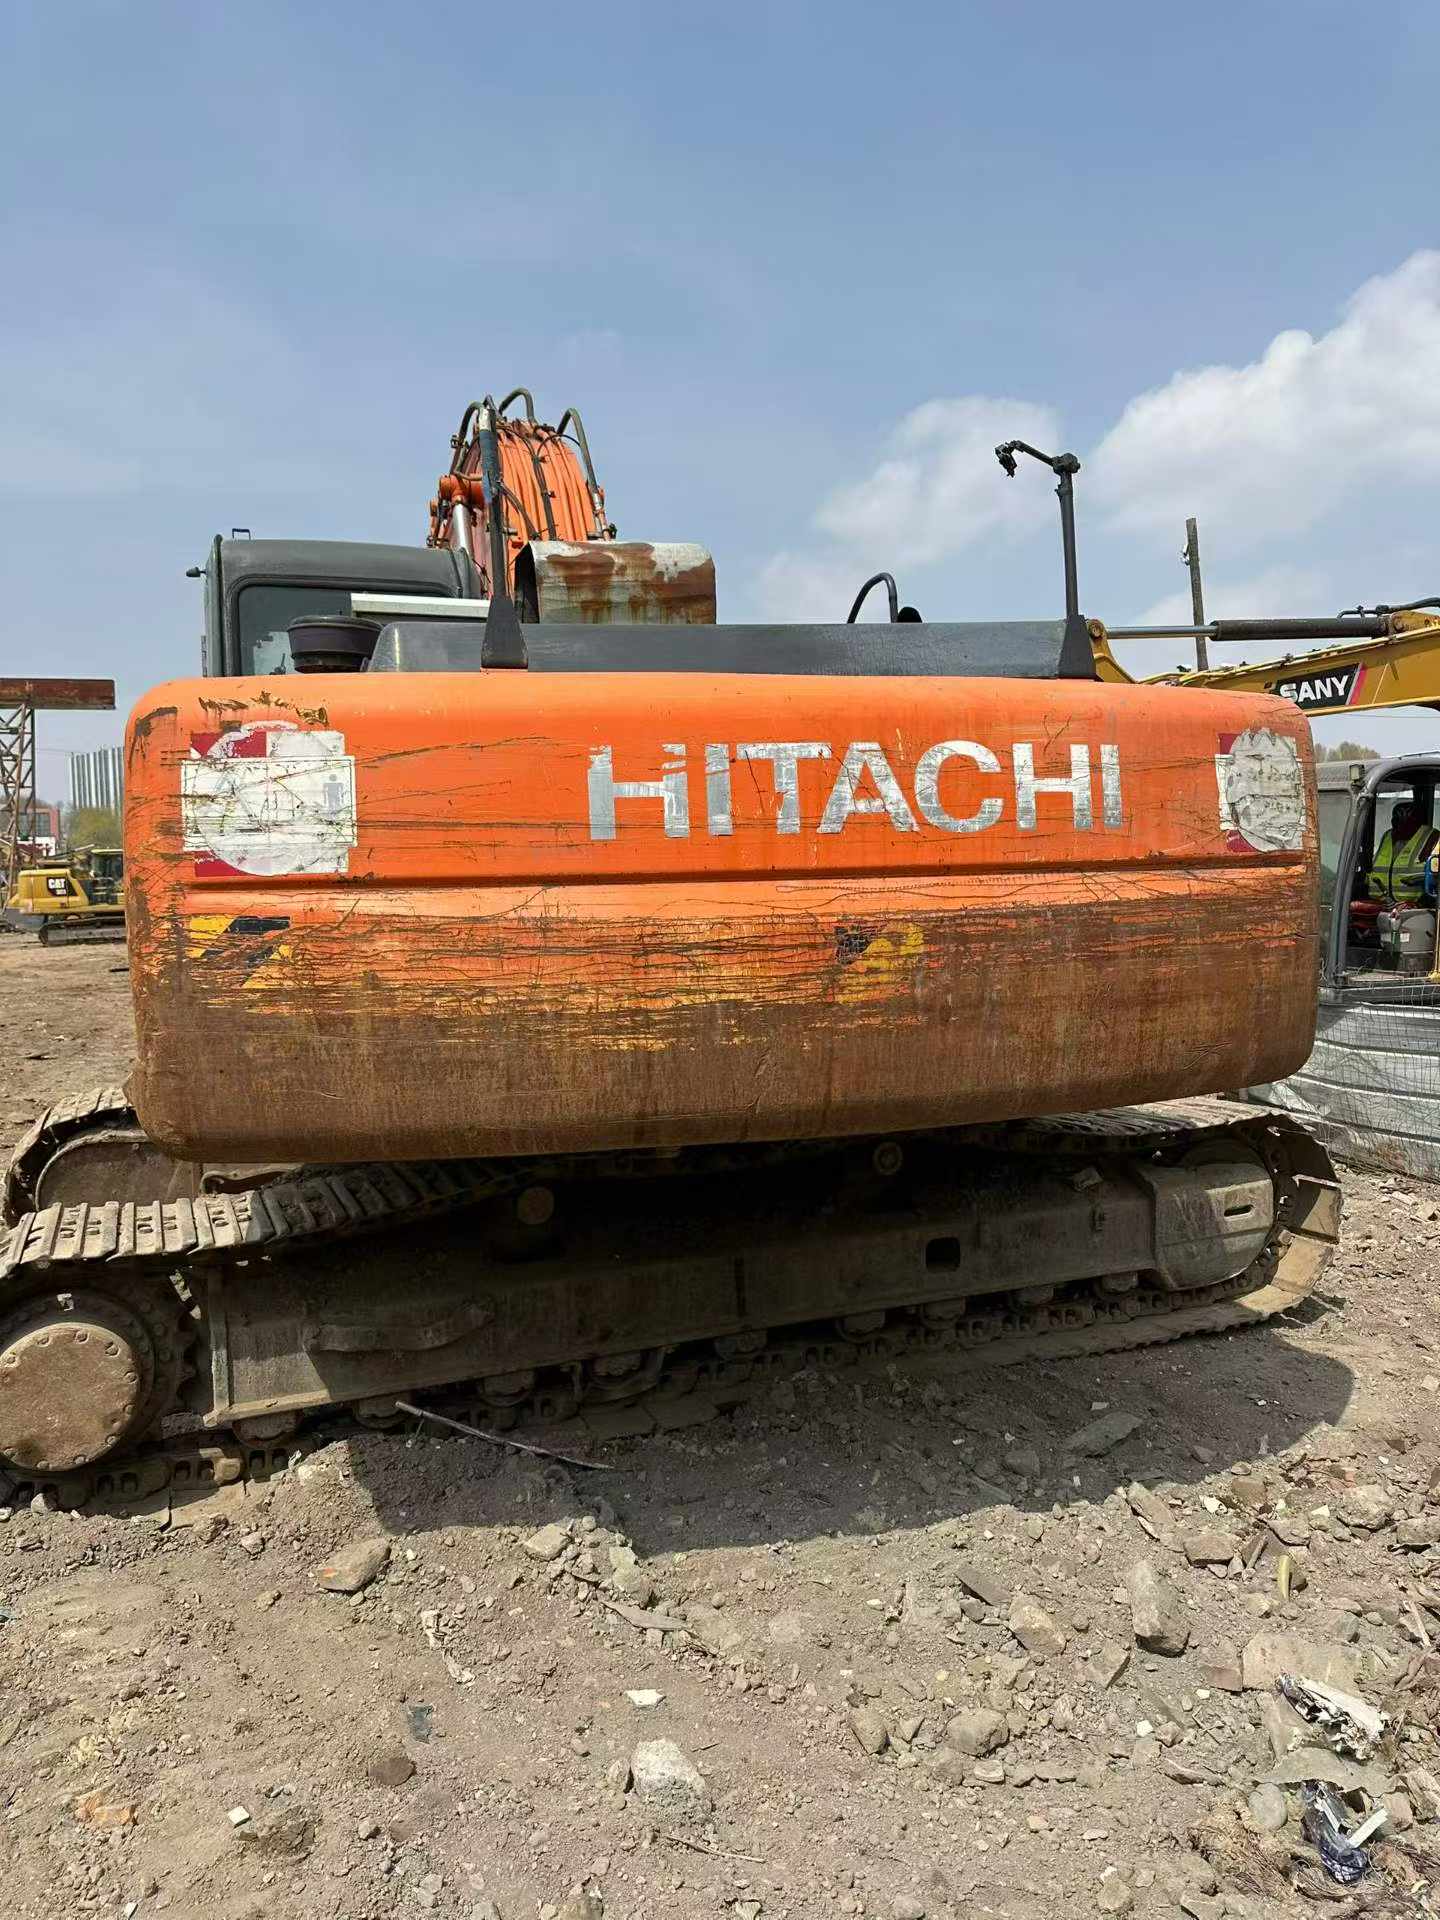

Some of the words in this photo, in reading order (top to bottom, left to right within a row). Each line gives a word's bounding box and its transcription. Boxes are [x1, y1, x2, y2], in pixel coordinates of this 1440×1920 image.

[1280, 675, 1348, 703] SANY
[588, 740, 1122, 840] HITACHI
[48, 879, 65, 889] CAT
